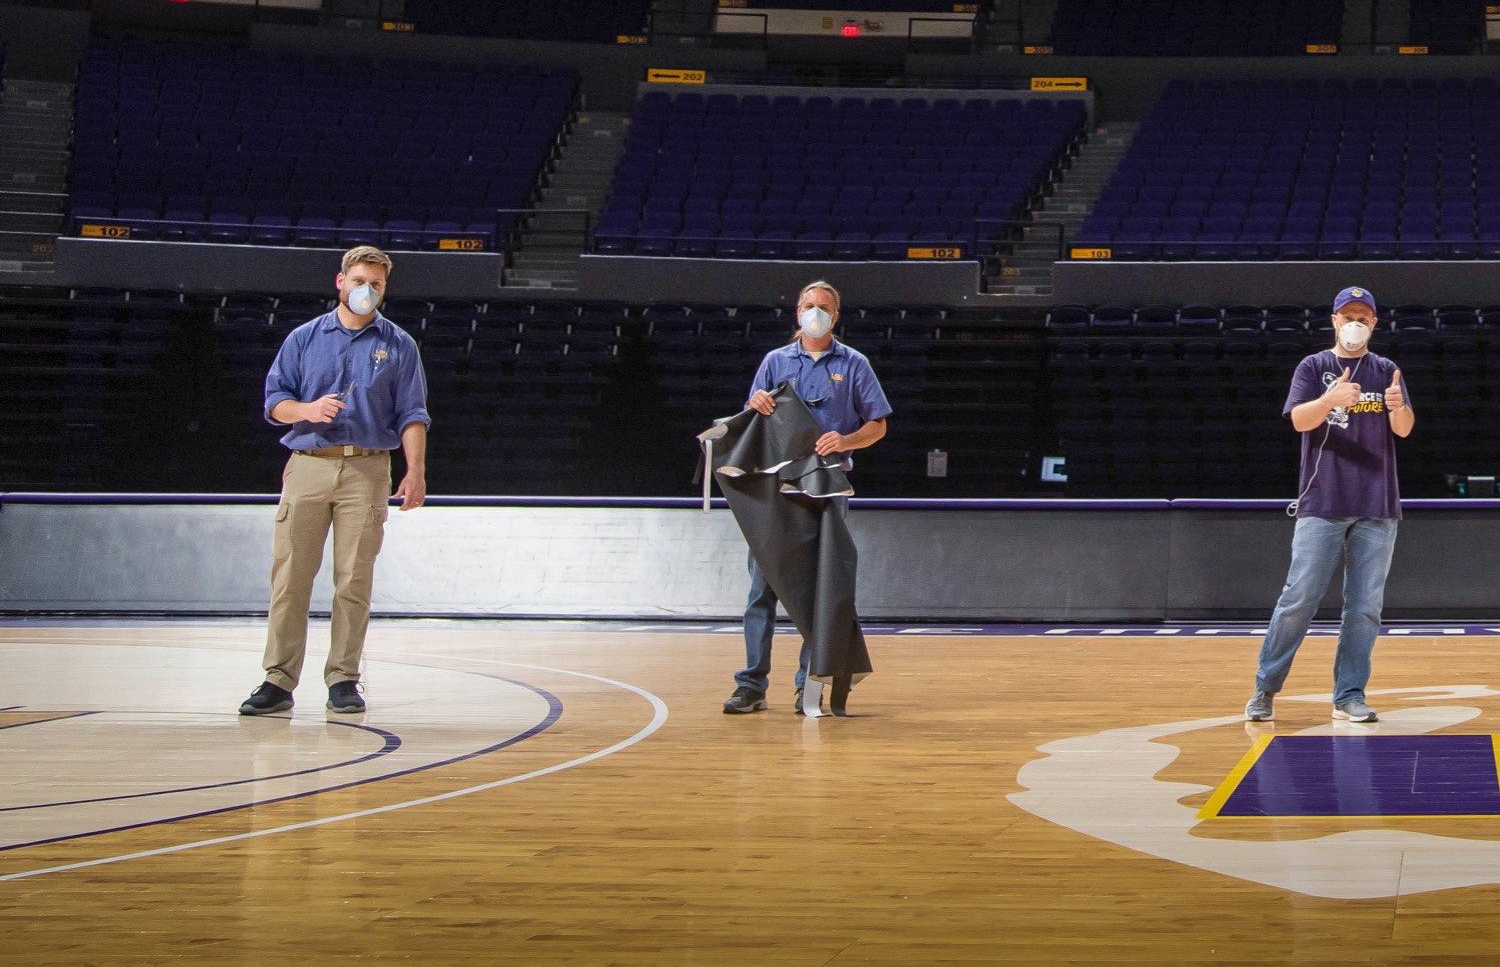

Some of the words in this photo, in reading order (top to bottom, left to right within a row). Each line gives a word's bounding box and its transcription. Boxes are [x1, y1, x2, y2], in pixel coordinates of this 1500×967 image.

[101, 227, 129, 237] 102
[456, 239, 482, 248] 102
[931, 248, 954, 257] 102
